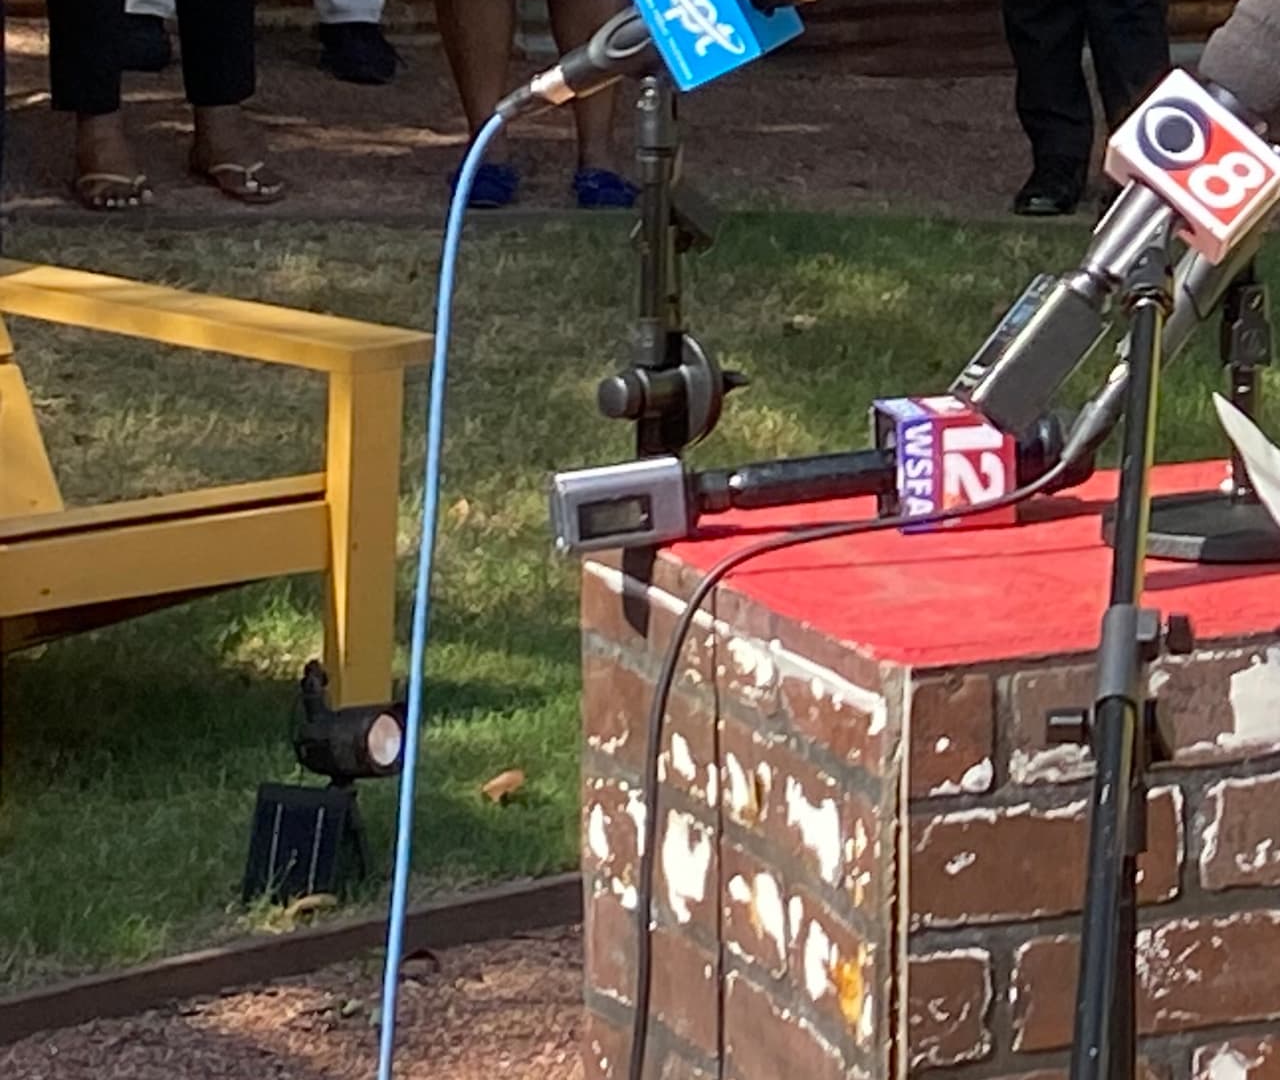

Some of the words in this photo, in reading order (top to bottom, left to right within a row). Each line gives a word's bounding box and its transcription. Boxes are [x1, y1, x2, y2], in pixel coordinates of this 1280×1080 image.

[1187, 151, 1266, 209] 8
[904, 421, 935, 518] WSFA
[942, 423, 1006, 527] 12
